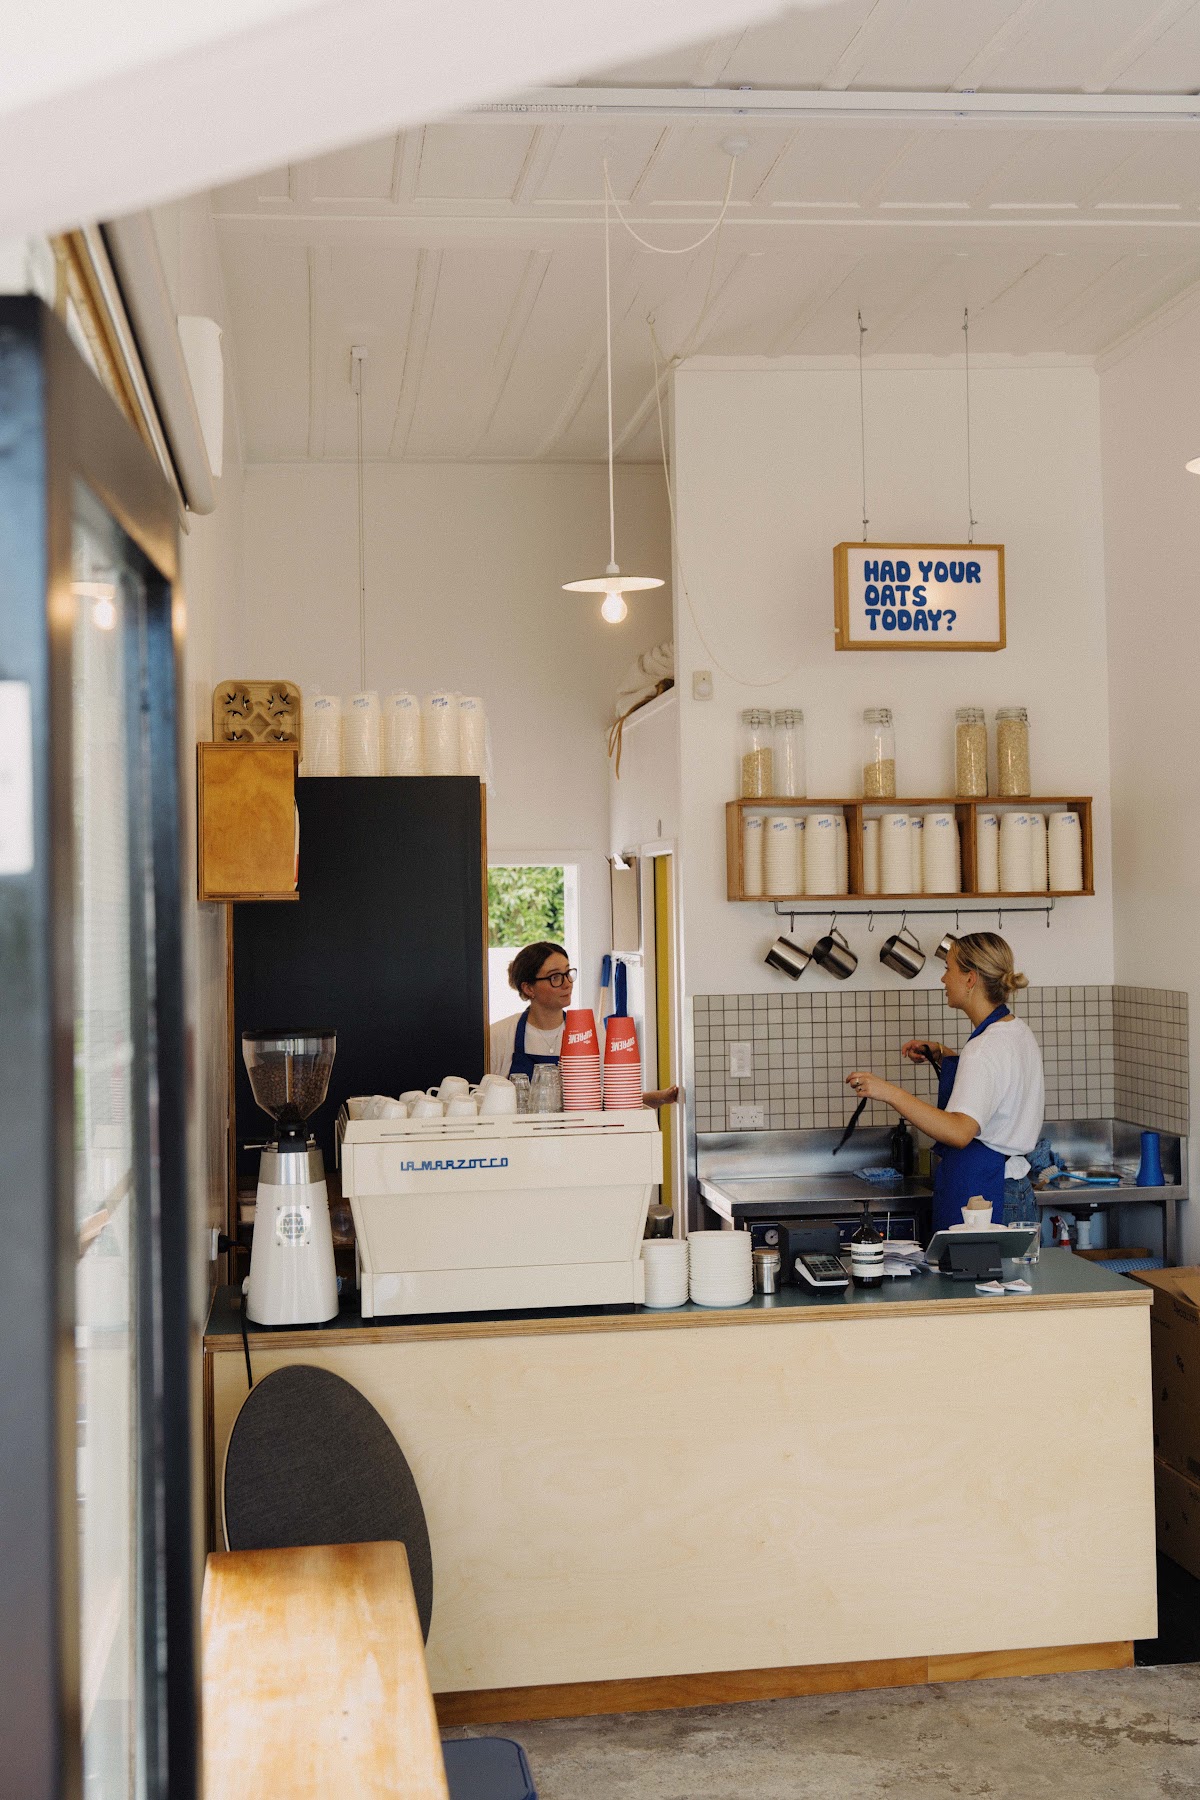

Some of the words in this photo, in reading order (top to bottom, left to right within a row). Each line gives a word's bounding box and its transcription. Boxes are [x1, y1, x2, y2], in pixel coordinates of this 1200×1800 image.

[864, 560, 911, 582] HAD
[918, 561, 981, 583] YOUR
[864, 585, 927, 607] OATS
[865, 609, 957, 631] TODAY?
[568, 1029, 593, 1045] SUPREME
[611, 1036, 635, 1052] SUPREME
